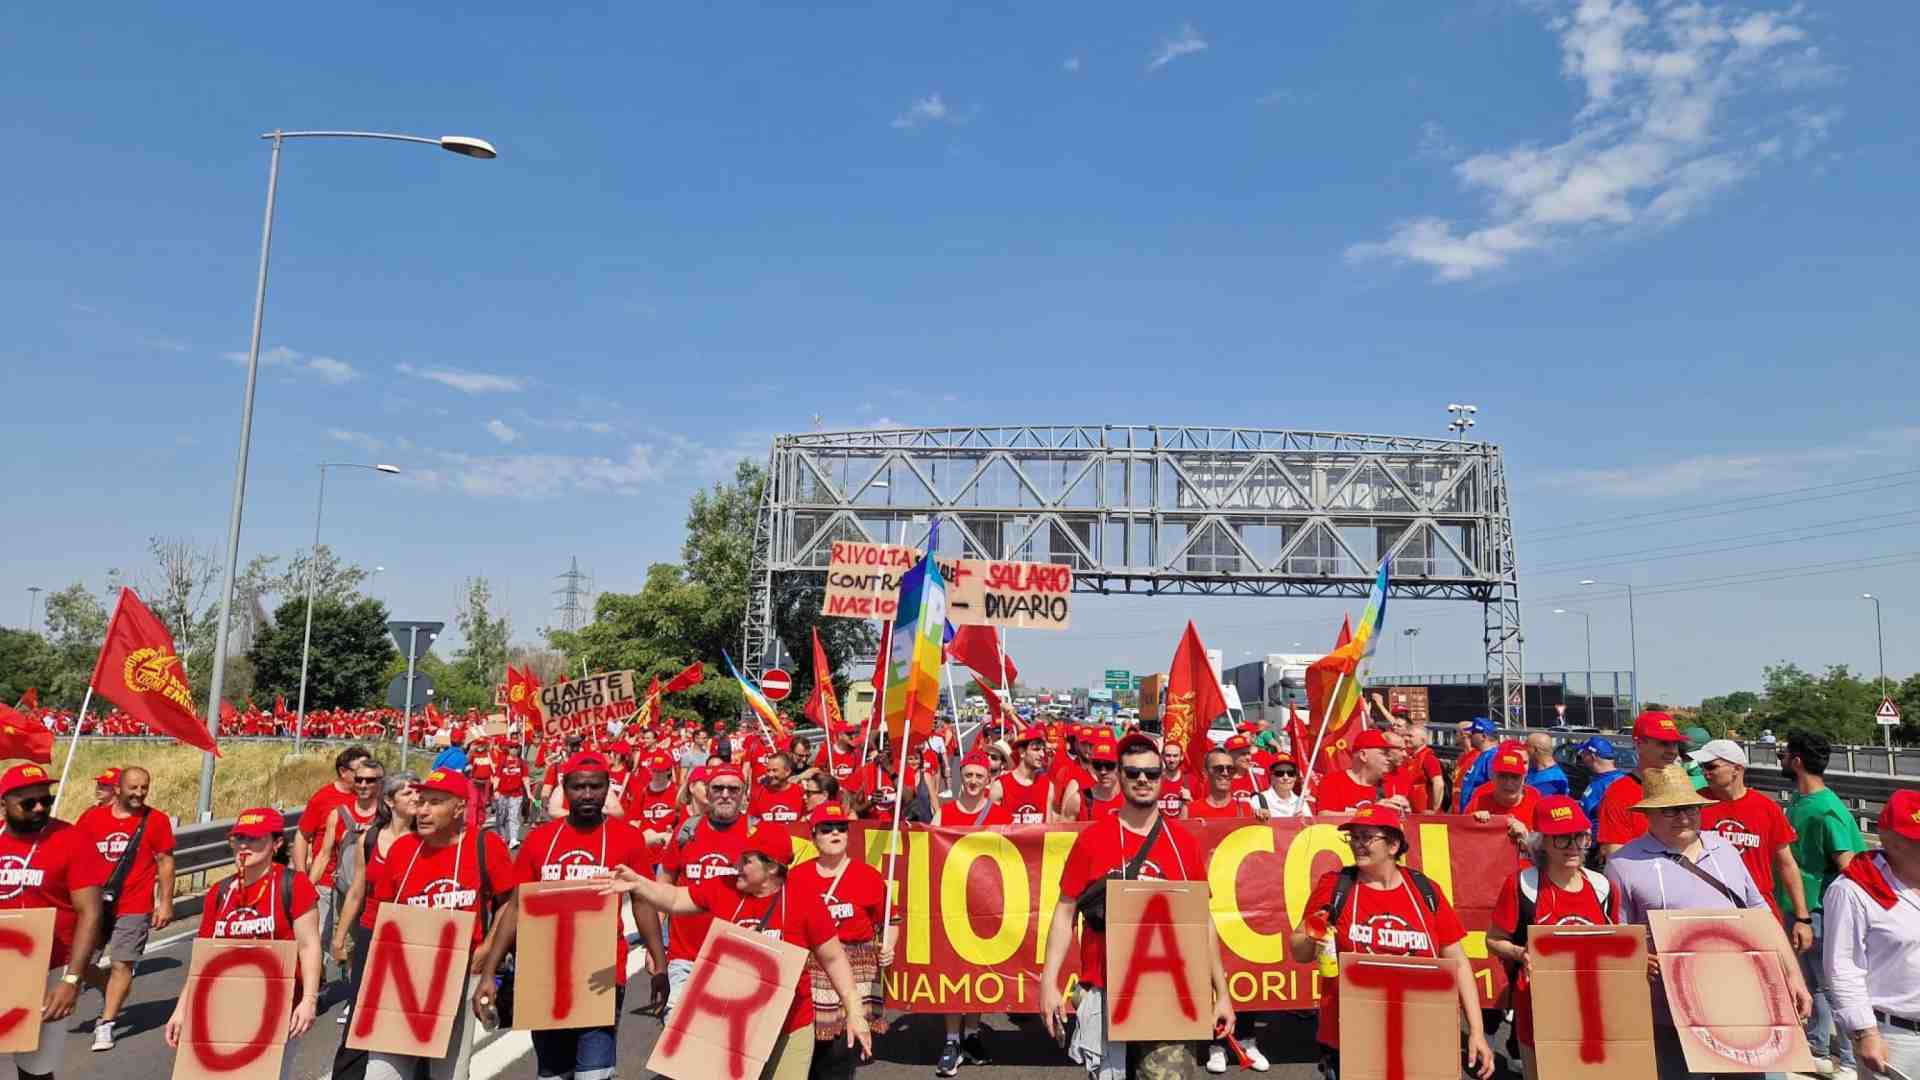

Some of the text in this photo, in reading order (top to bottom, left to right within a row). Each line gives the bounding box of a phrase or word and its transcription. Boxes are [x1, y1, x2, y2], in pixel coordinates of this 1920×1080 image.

[831, 543, 912, 568] RIVOLTA
[829, 572, 902, 590] CONTRA
[985, 564, 1071, 592] SALARIO
[828, 595, 896, 614] NAZIO
[985, 592, 1068, 622] DIVARIO
[561, 673, 623, 700] AVETE
[550, 693, 604, 717] ROTTO
[1349, 924, 1429, 950] OGGI SCIOPERO
[522, 888, 606, 1021] T
[1111, 891, 1198, 1025] A
[353, 920, 457, 1042] N
[882, 971, 1004, 1004] NIAMO
[1667, 923, 1796, 1066] O
[191, 945, 285, 1073] O
[662, 935, 781, 1080] R
[1534, 935, 1639, 1066] T
[1345, 963, 1457, 1080] T
